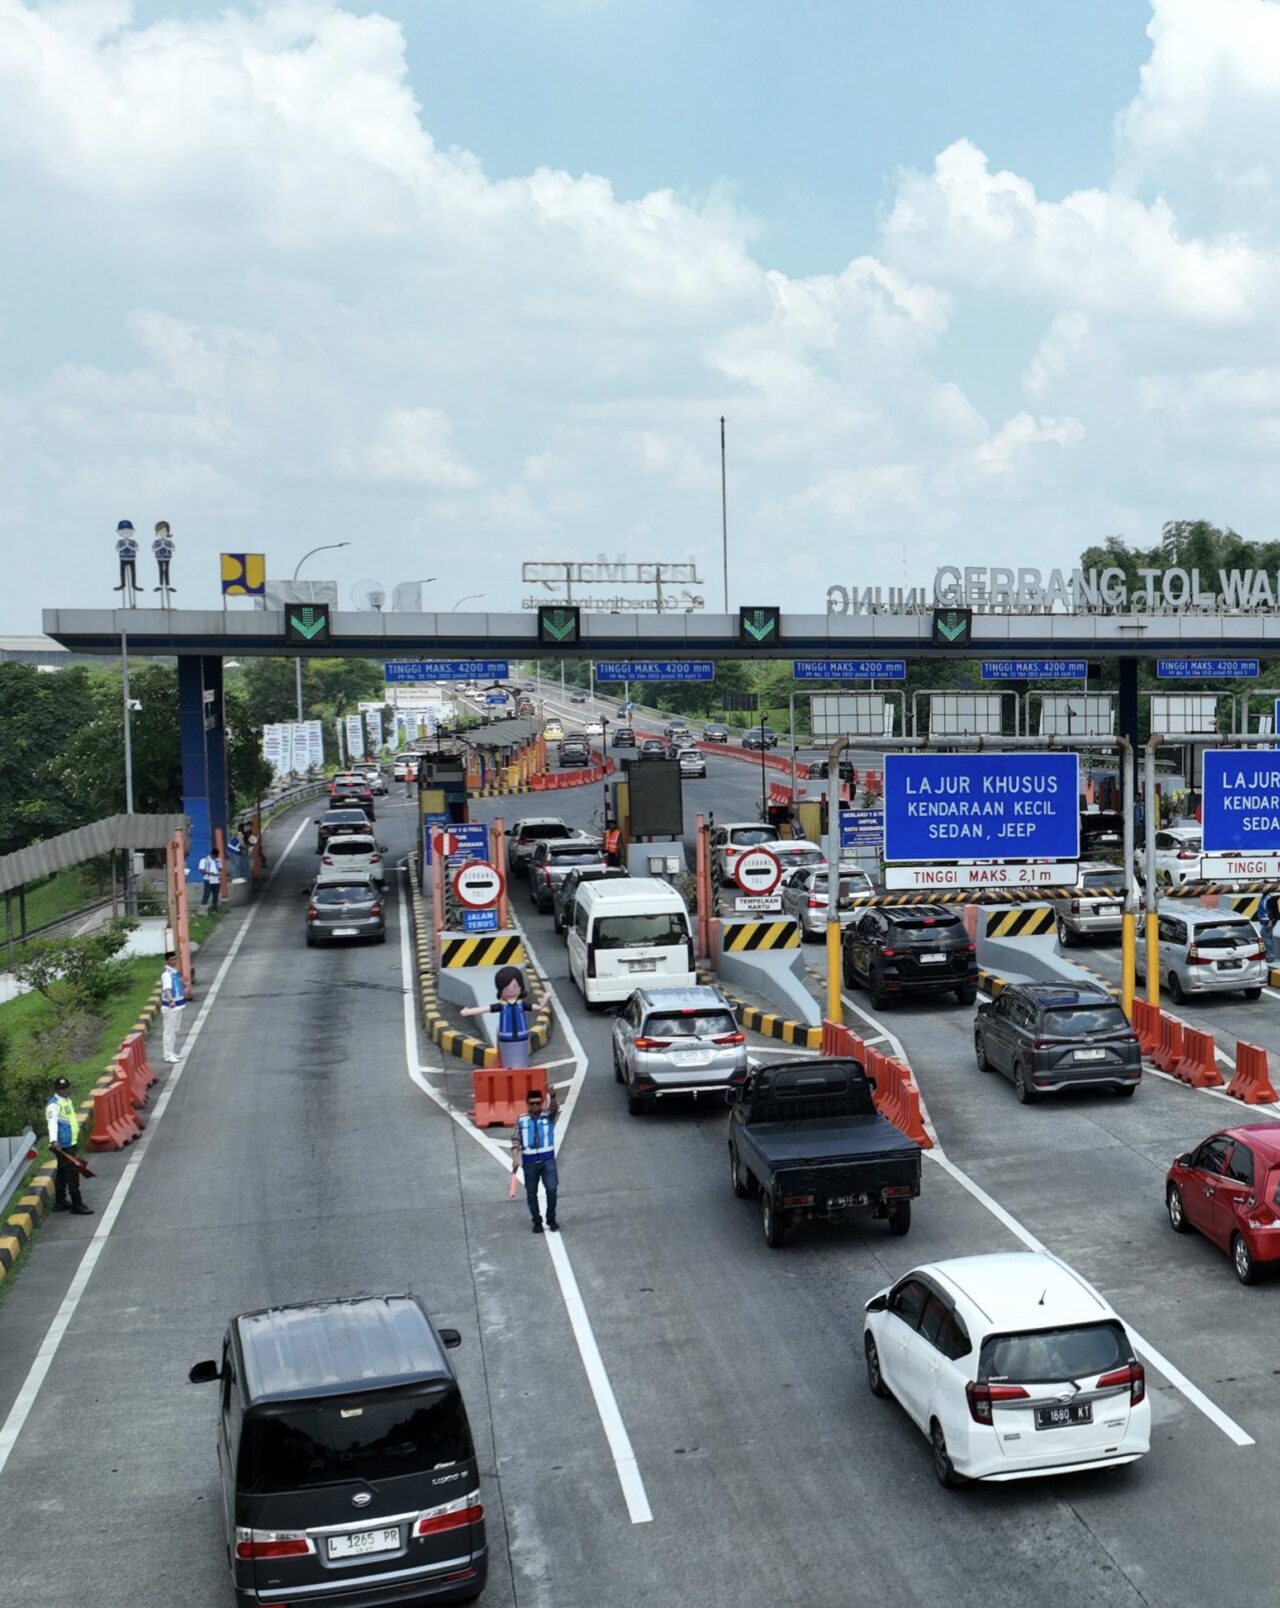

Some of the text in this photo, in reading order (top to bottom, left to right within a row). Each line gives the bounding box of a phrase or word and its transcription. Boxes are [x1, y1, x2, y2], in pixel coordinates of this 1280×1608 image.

[934, 566, 1127, 606] GERBANG
[1136, 567, 1211, 607] TOL
[388, 663, 506, 674] TINGGI MAKS. 4200 mm
[600, 664, 711, 673] TINGGI MAKS. 4200 mm
[796, 663, 902, 672] TINGGI MAKS. 4200 mm
[984, 662, 1085, 672] TINGGI MAKS. 4200 mm
[1160, 661, 1256, 671] TINGGI MAKS. 4200 mm
[906, 776, 1058, 794] LAJUR KHUSUS
[1222, 771, 1280, 788] LAJUR
[908, 801, 1056, 816] KENDARAAN KECIL
[997, 823, 1036, 838] JEEP
[1227, 862, 1267, 874] TINGGI
[913, 871, 957, 883] TINGGI
[969, 870, 1011, 882] MAKS.
[467, 912, 493, 920] JALAN
[467, 921, 494, 929] TERUS
[1037, 1412, 1043, 1423] L
[1077, 1406, 1089, 1418] KT
[330, 1530, 397, 1551] L 1265 PR
